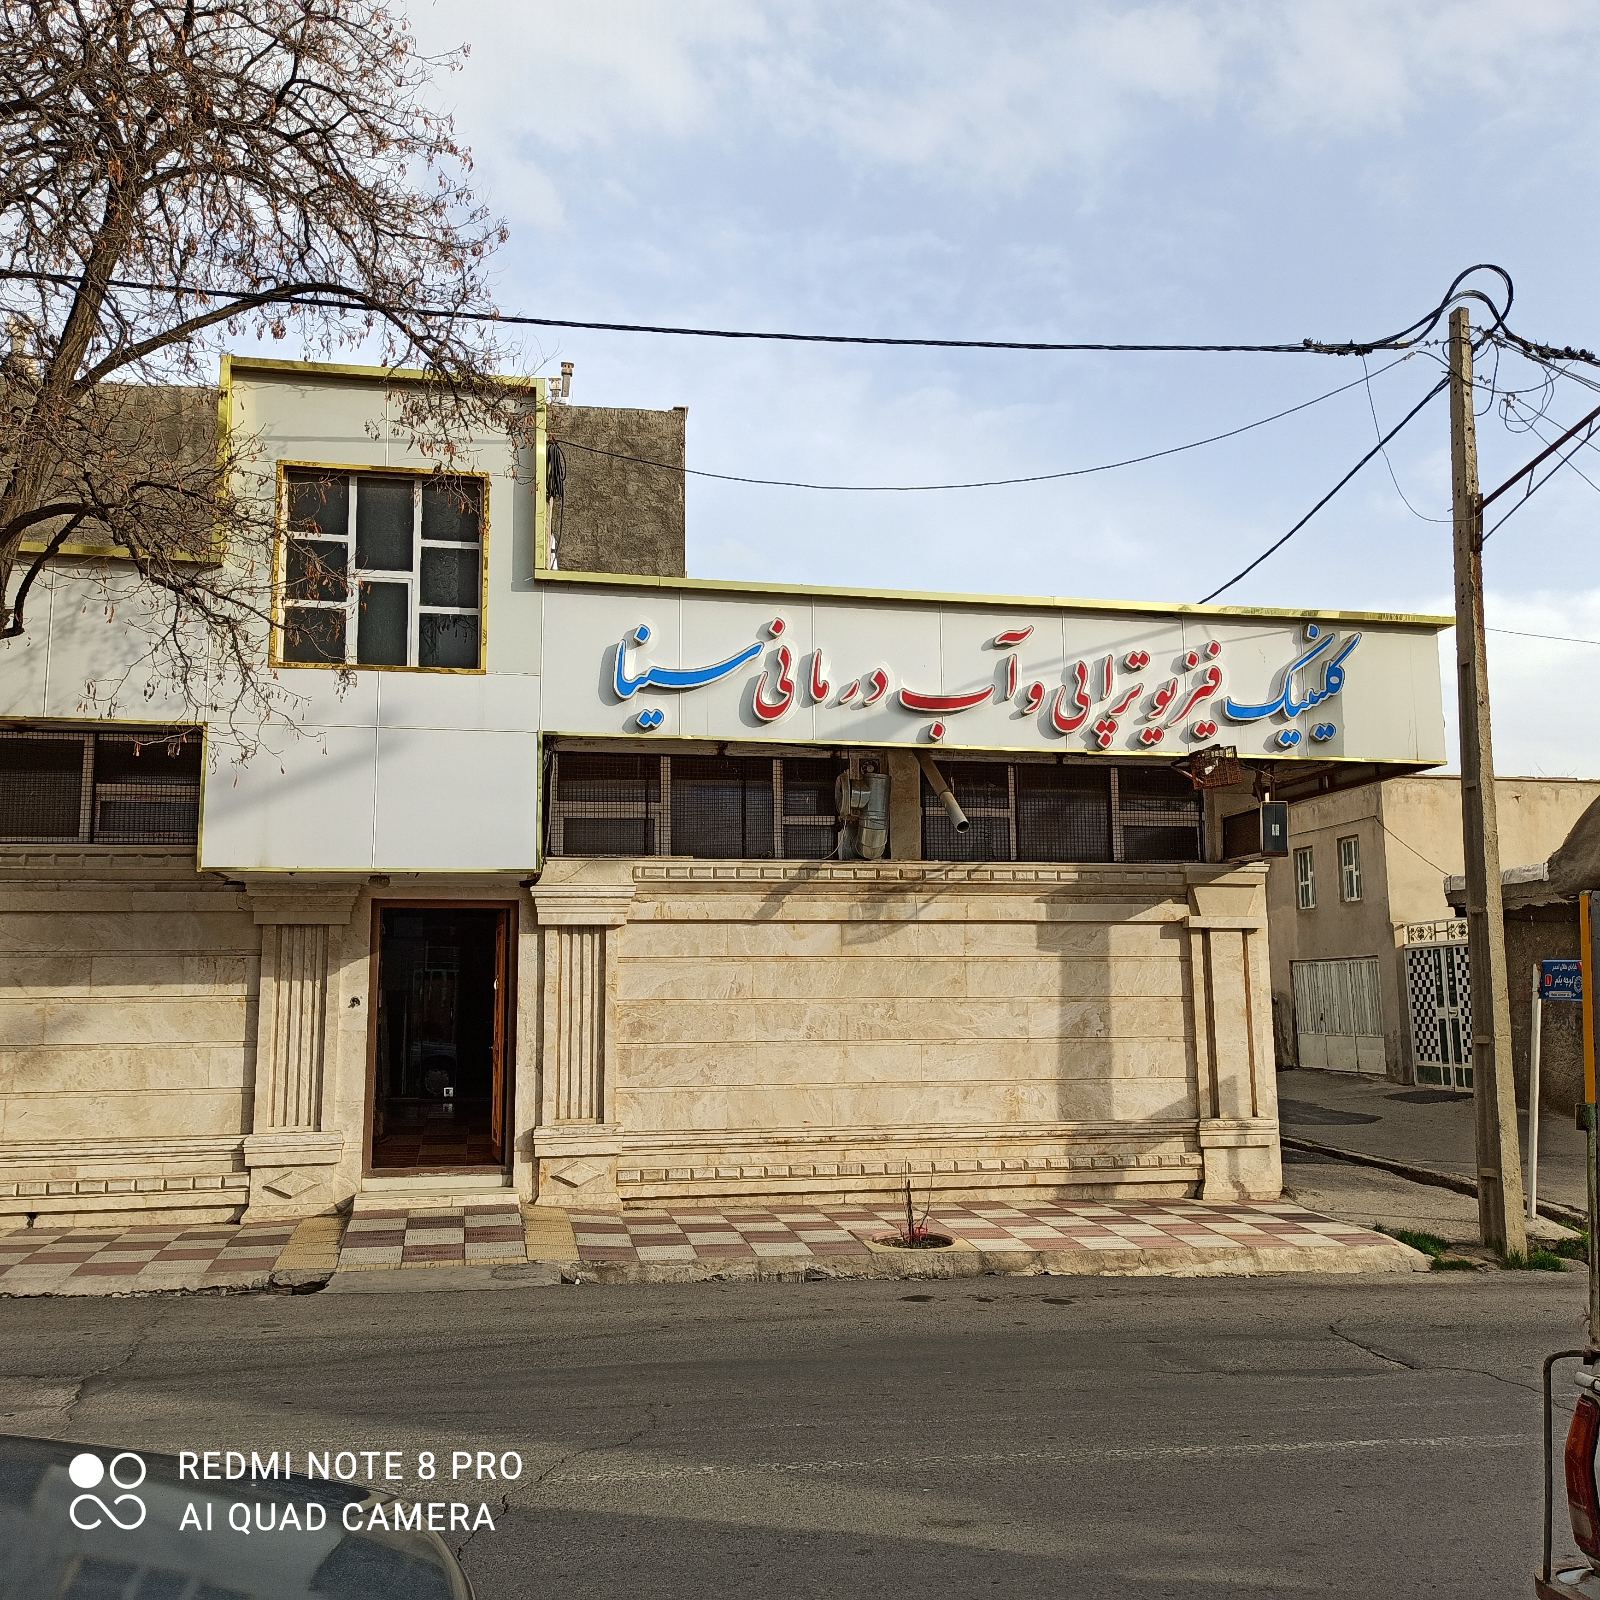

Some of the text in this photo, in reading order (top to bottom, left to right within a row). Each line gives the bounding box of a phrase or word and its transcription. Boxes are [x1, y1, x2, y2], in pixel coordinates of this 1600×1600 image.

[613, 623, 766, 731] سینا
[752, 616, 890, 723] درمانی
[899, 624, 1034, 742] آب
[1023, 680, 1046, 716] و
[1223, 622, 1363, 748] کلینیک
[1563, 975, 1575, 988] کوچه
